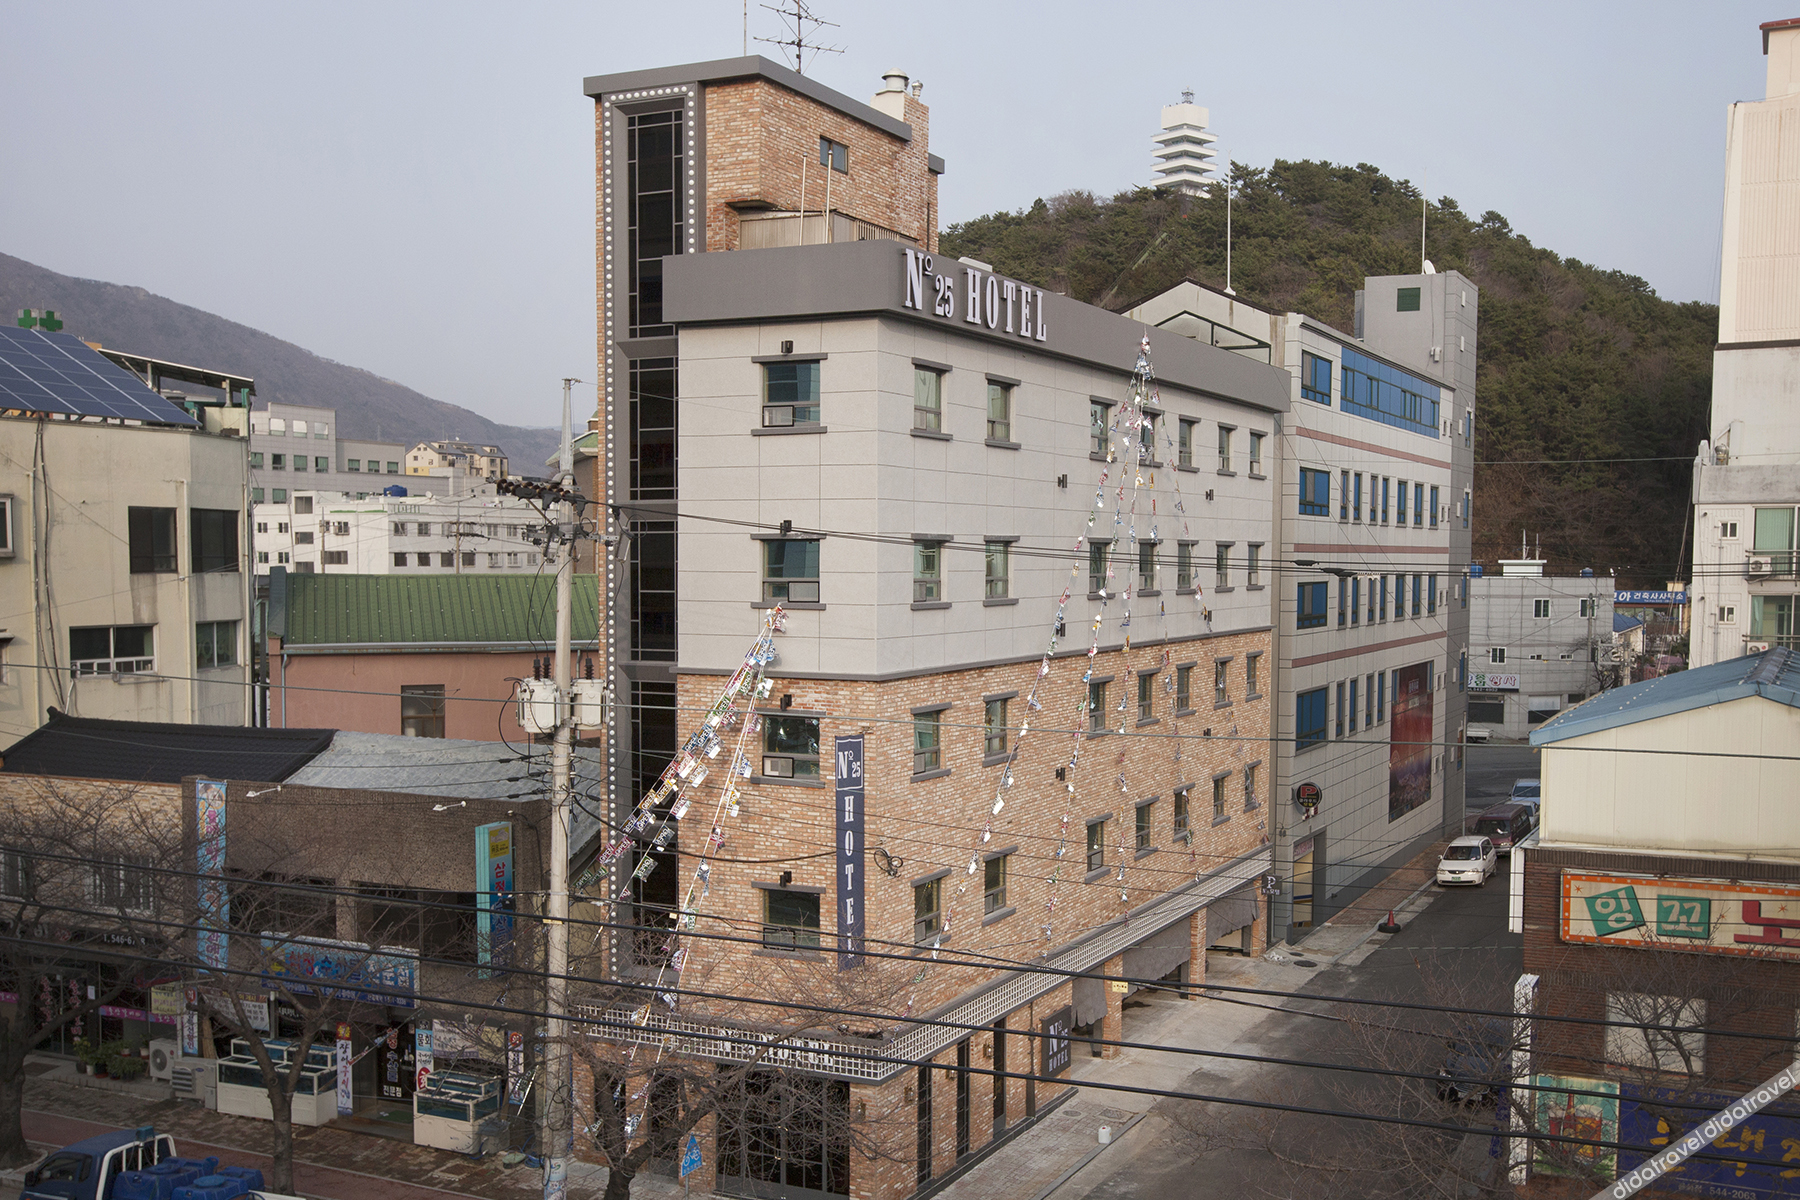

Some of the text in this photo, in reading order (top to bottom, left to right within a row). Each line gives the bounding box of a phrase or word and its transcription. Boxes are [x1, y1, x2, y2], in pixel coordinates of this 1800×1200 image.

[935, 274, 955, 318] 25
[966, 267, 1047, 342] HOTEL
[852, 761, 861, 778] 25
[1300, 785, 1318, 798] P
[1266, 875, 1277, 889] P
[417, 1033, 431, 1048] 물회
[1060, 1028, 1069, 1048] 25
[339, 1043, 350, 1087] 장어구이
[387, 1050, 399, 1083] 수산물
[1049, 1049, 1069, 1072] HOTEL
[383, 1084, 402, 1098] 전문점
[1709, 1186, 1757, 1200] 544-2063
